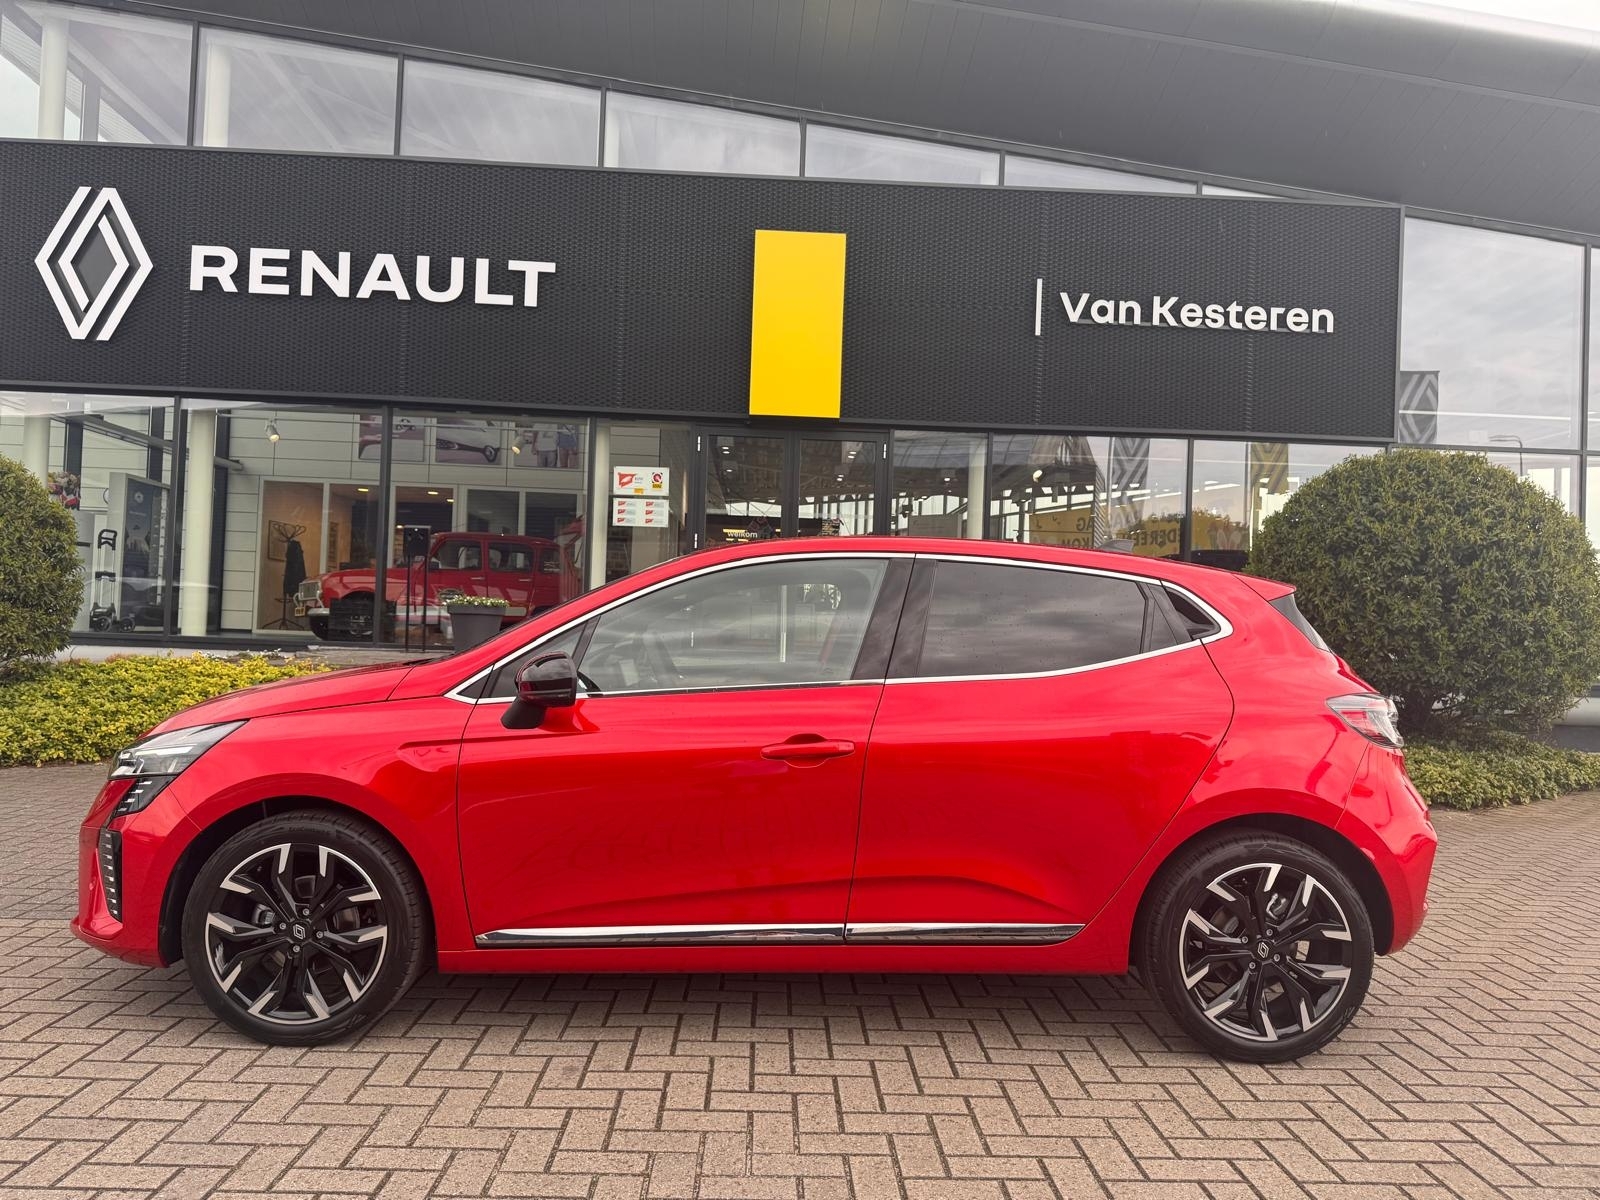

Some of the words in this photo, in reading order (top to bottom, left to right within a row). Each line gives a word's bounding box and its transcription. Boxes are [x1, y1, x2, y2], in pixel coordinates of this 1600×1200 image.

[189, 244, 557, 308] RENAULT
[1059, 291, 1141, 325] Van
[1152, 295, 1335, 333] Kesteren
